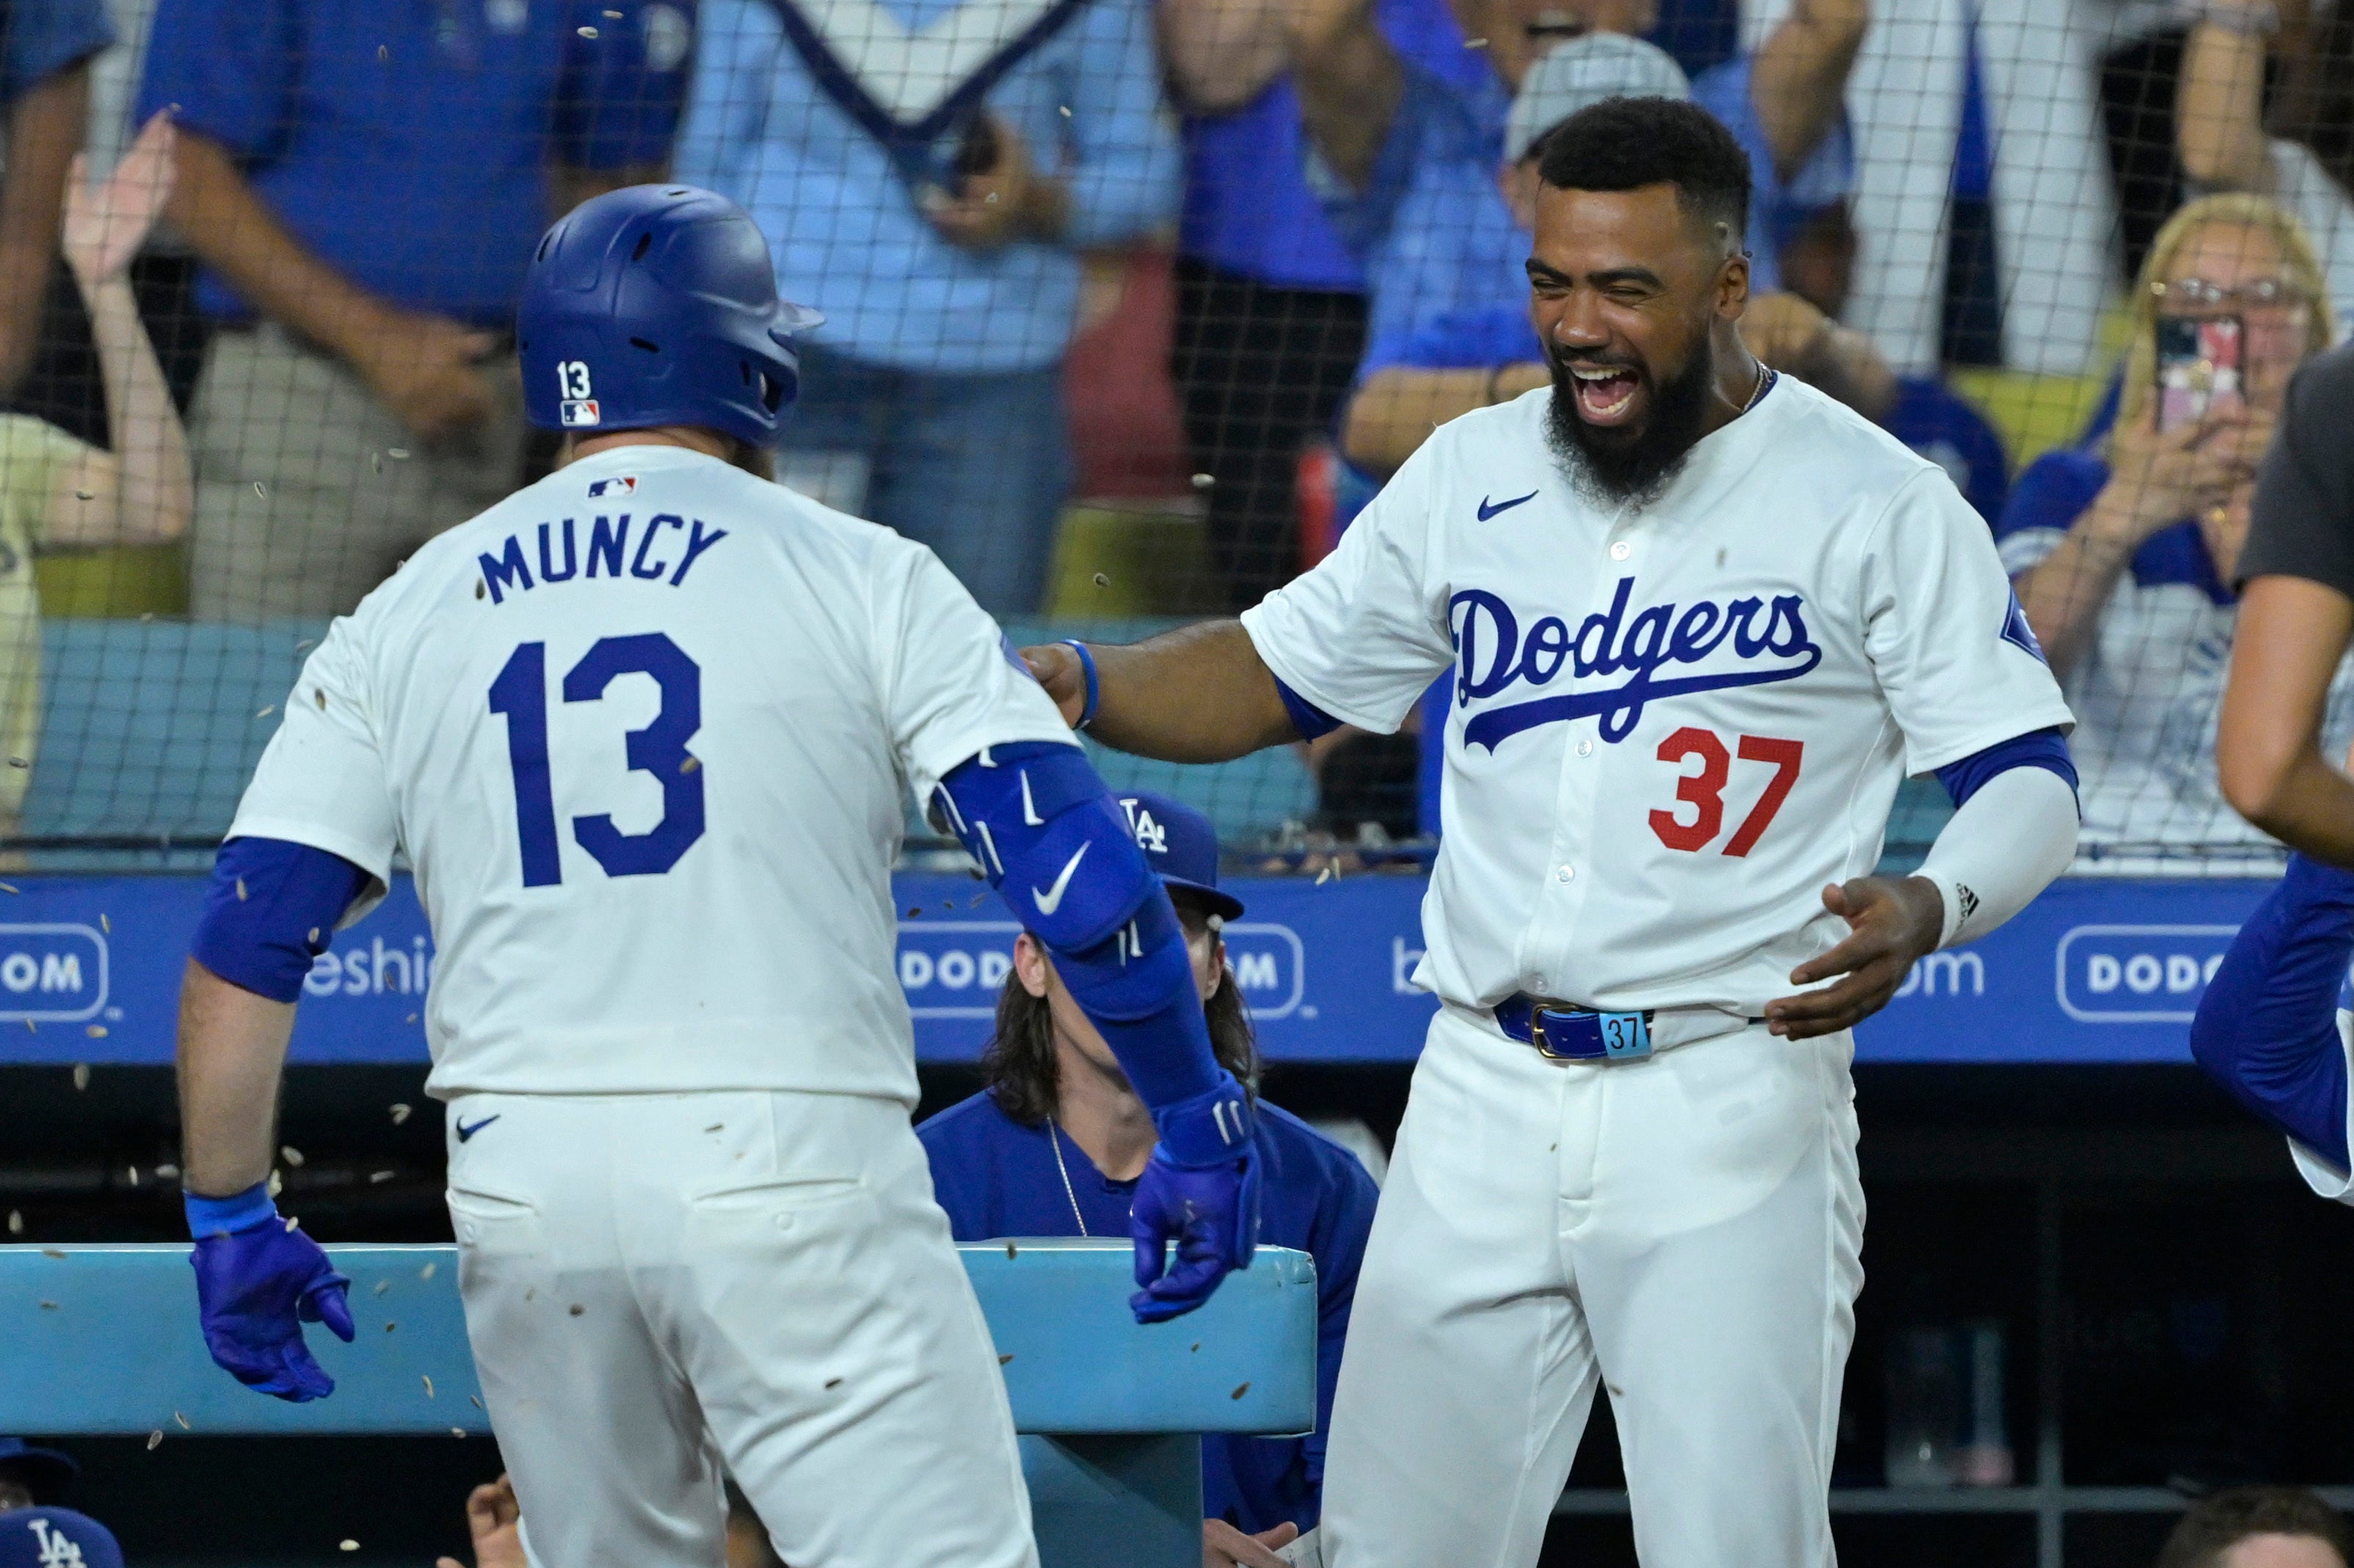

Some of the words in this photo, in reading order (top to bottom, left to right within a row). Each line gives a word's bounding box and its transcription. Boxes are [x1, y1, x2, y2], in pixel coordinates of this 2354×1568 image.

[557, 360, 591, 399] 13
[478, 513, 729, 605] MUNCY
[1448, 576, 1822, 744] Dodgers
[488, 631, 706, 888] 13
[1648, 726, 1805, 857] 37
[1118, 798, 1168, 853] LA
[303, 934, 436, 996] eshi
[1225, 952, 1279, 990] M
[1608, 1017, 1638, 1050] 37
[27, 1517, 88, 1568] LA
